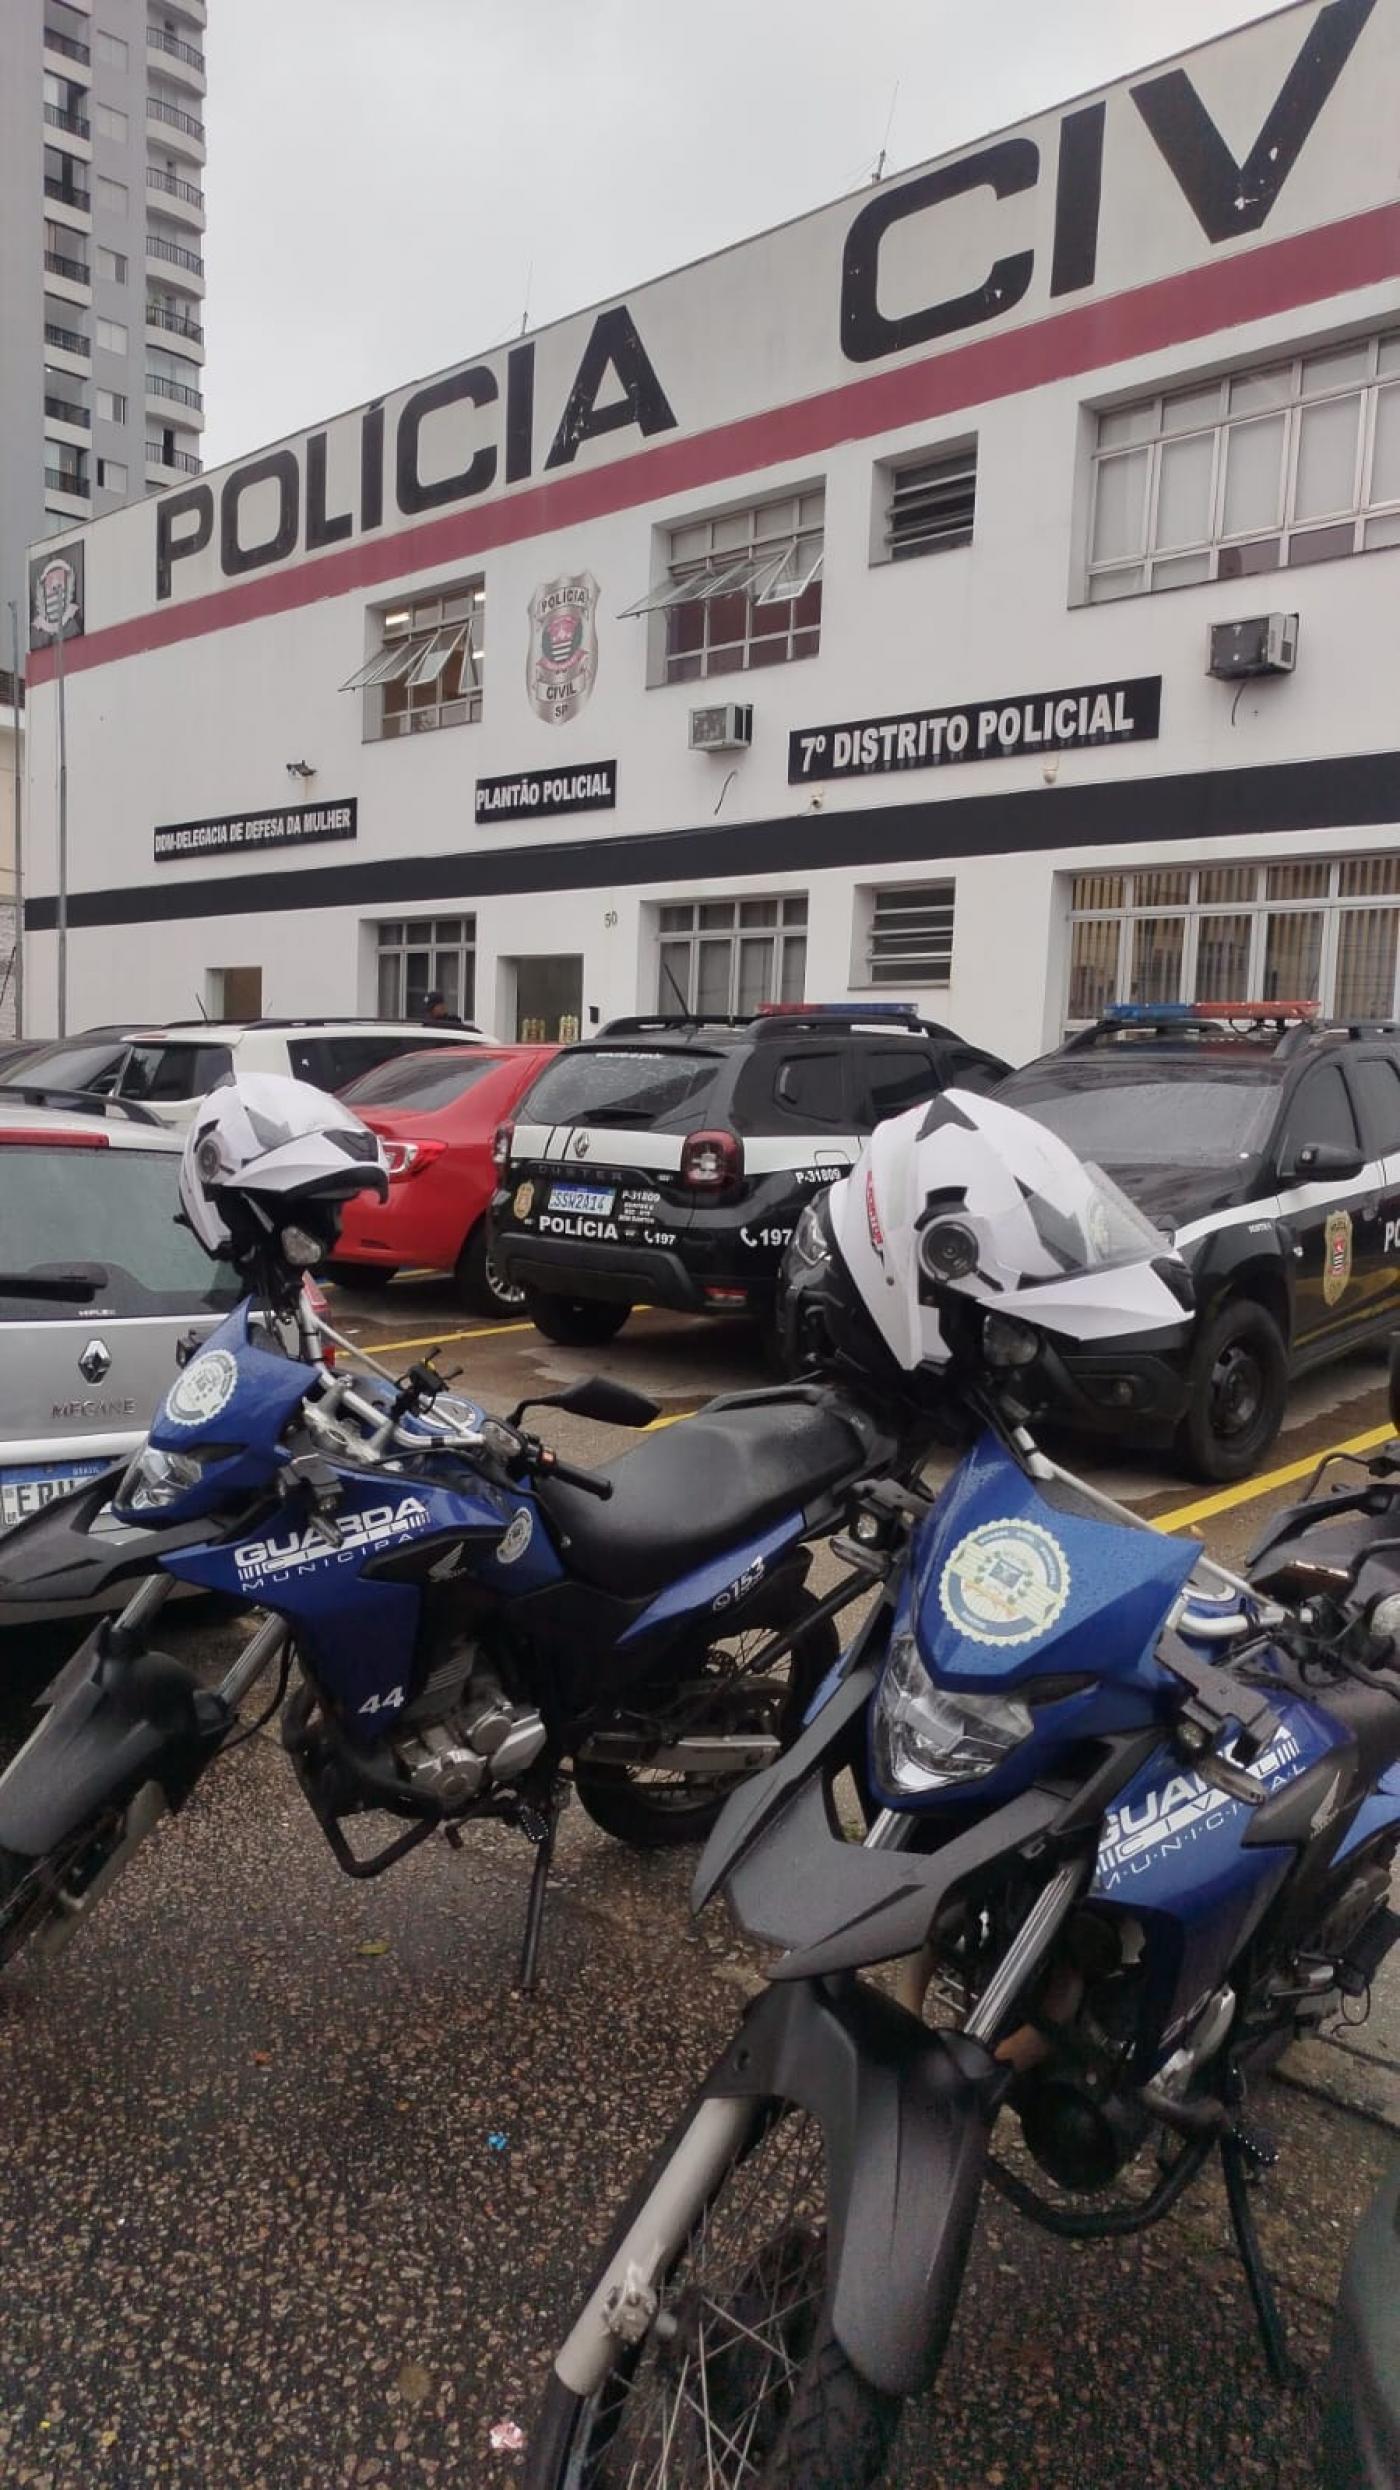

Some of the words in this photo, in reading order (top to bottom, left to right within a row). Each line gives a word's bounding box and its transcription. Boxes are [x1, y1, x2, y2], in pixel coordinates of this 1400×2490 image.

[157, 304, 678, 600] POLÍCIA
[546, 682, 576, 700] CIVIL
[555, 705, 568, 717] SP
[833, 715, 968, 768] DISTRITO
[977, 692, 1134, 749] POLICIAL
[476, 779, 540, 811] PLANTÃO
[543, 772, 611, 803] POLICIAL
[230, 822, 244, 842] DE
[245, 817, 284, 840] DEFESA
[287, 815, 301, 835] DA
[303, 808, 351, 832] MULHER
[539, 1215, 618, 1240] POLÍCIA
[654, 1233, 676, 1245] 197
[759, 1229, 793, 1246] 197
[358, 1686, 404, 1714] 44
